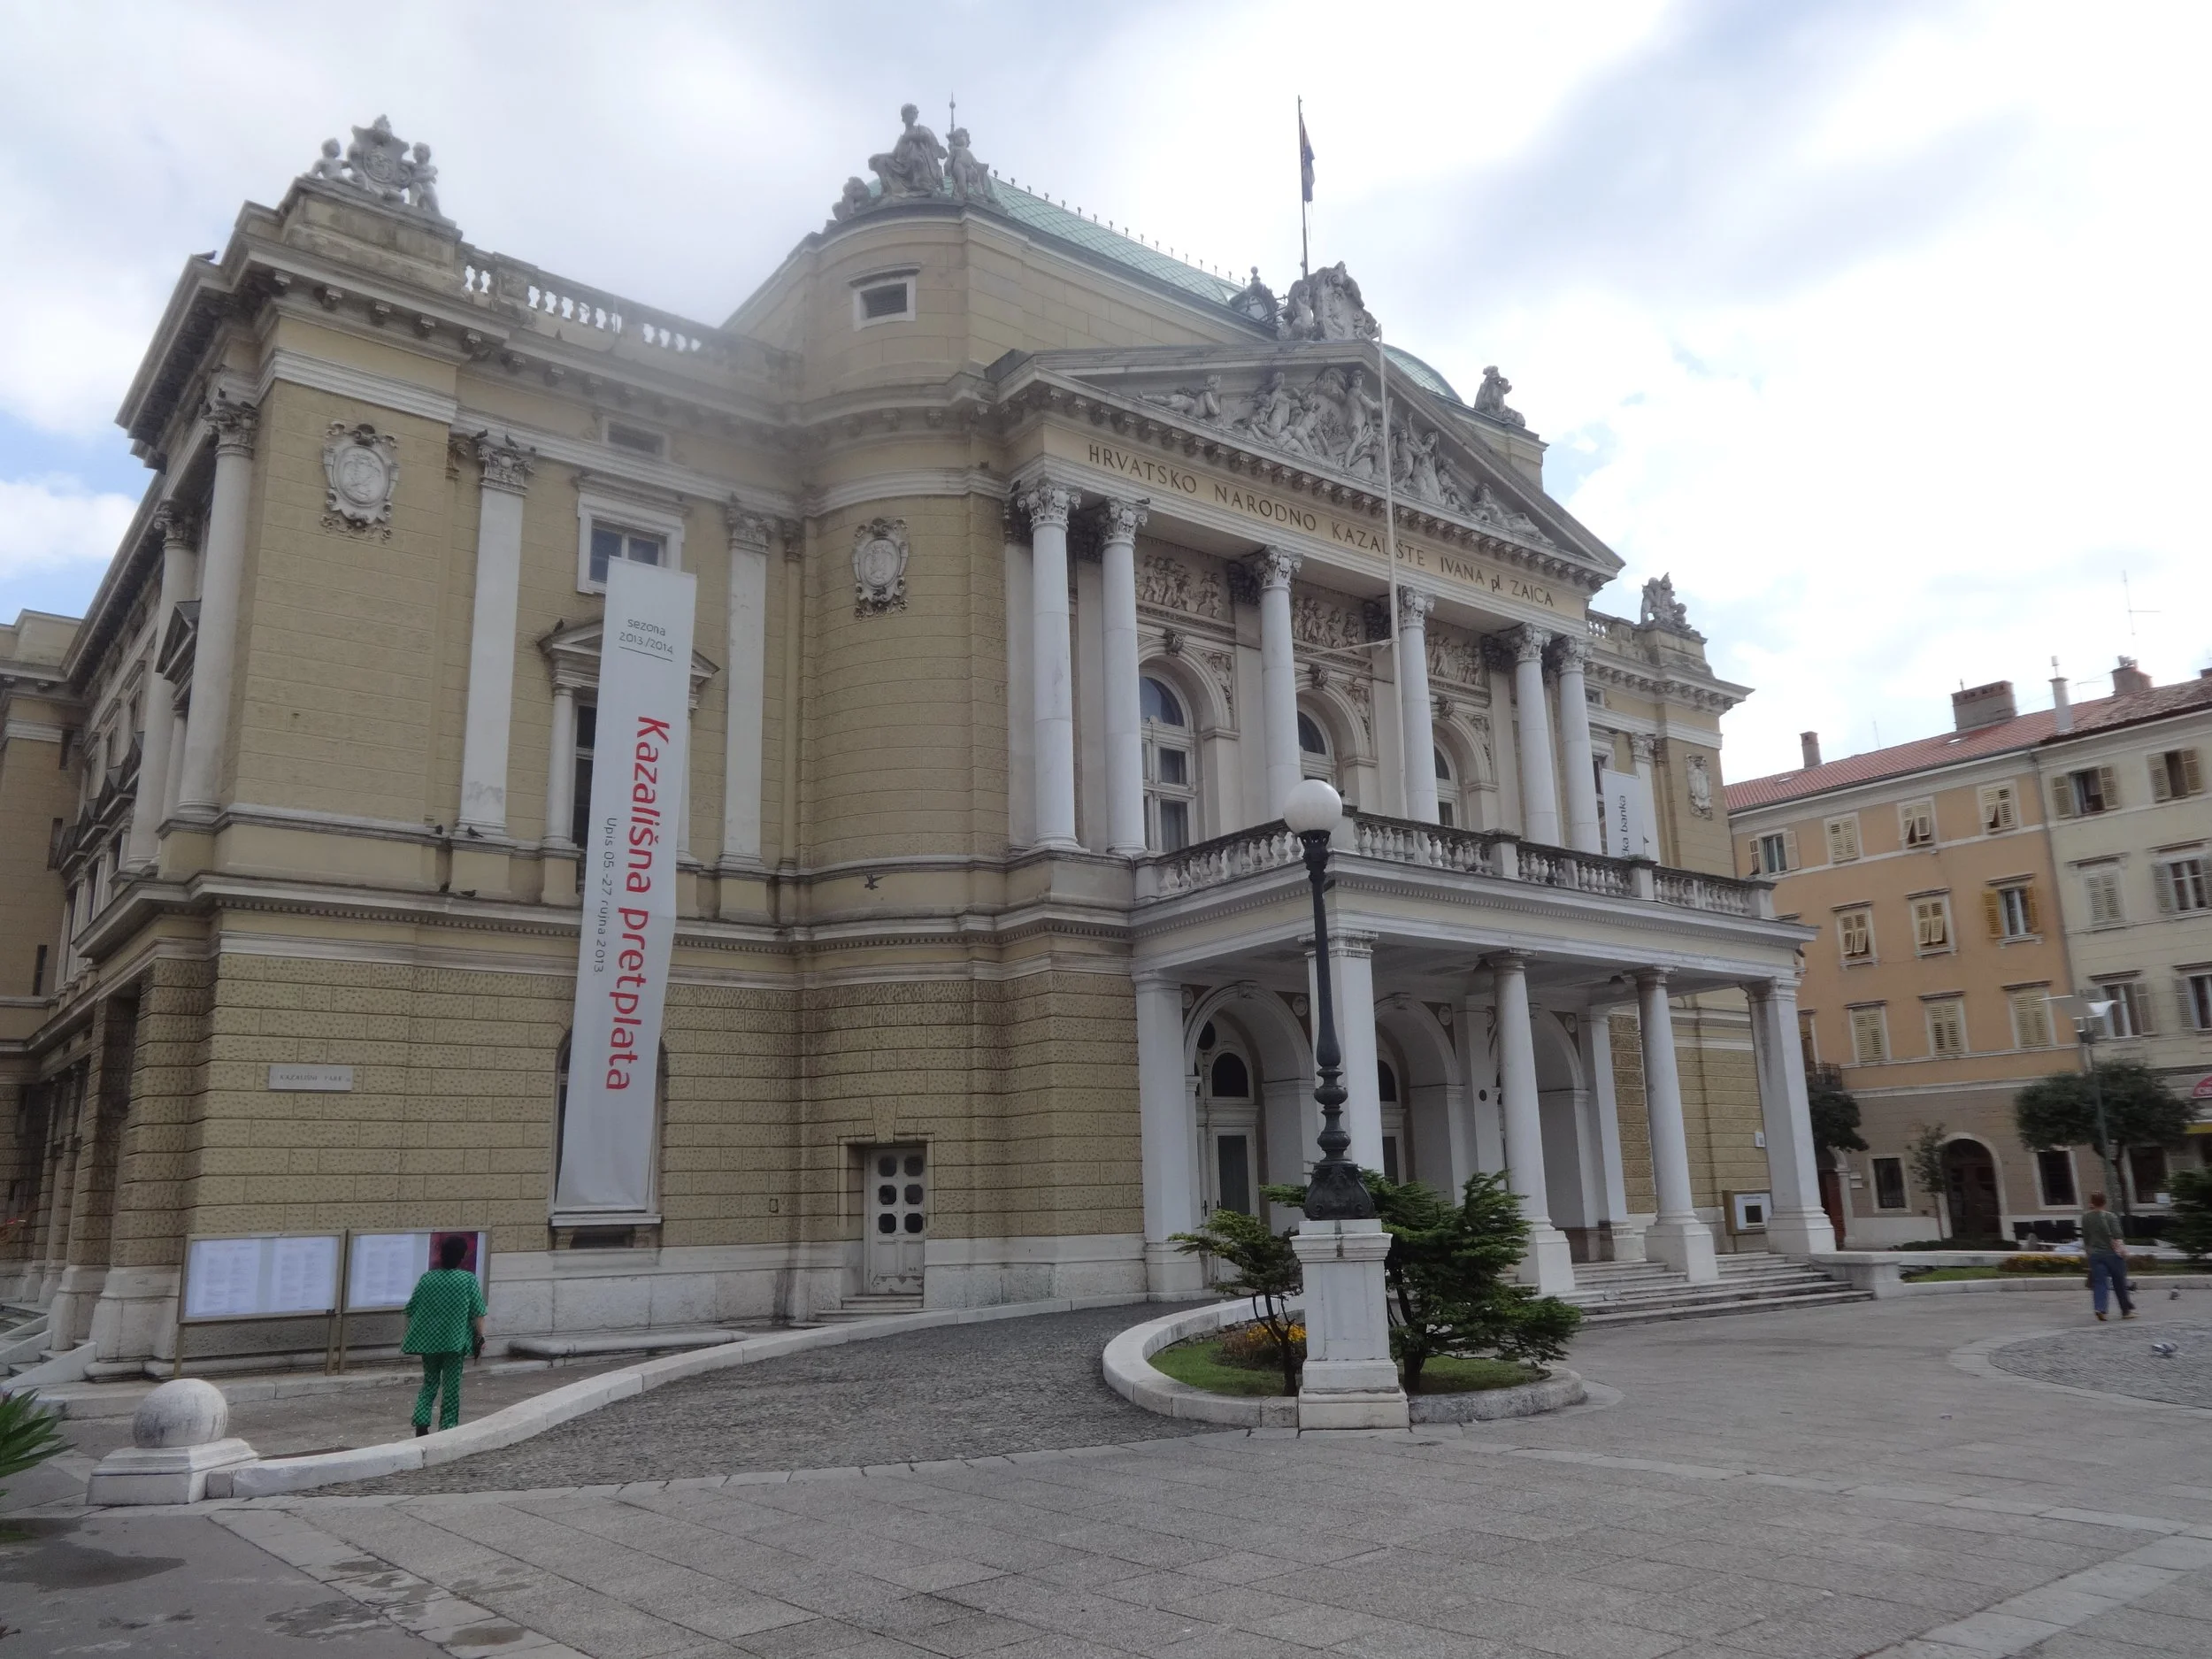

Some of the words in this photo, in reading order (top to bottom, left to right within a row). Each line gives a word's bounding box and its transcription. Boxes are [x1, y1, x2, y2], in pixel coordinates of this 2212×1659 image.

[1088, 444, 1197, 494] HRVATSKO
[1215, 484, 1317, 531] NARODNO
[1331, 522, 1425, 566] KAZALŠTE
[1440, 557, 1486, 585] IVANA
[1491, 574, 1502, 592] pl.
[1510, 580, 1554, 607] ZAICA
[627, 618, 666, 636] sezona
[604, 818, 618, 847] Upis
[626, 717, 669, 894] Kazališna
[595, 900, 609, 935] rujna
[606, 906, 648, 1091] pretplata
